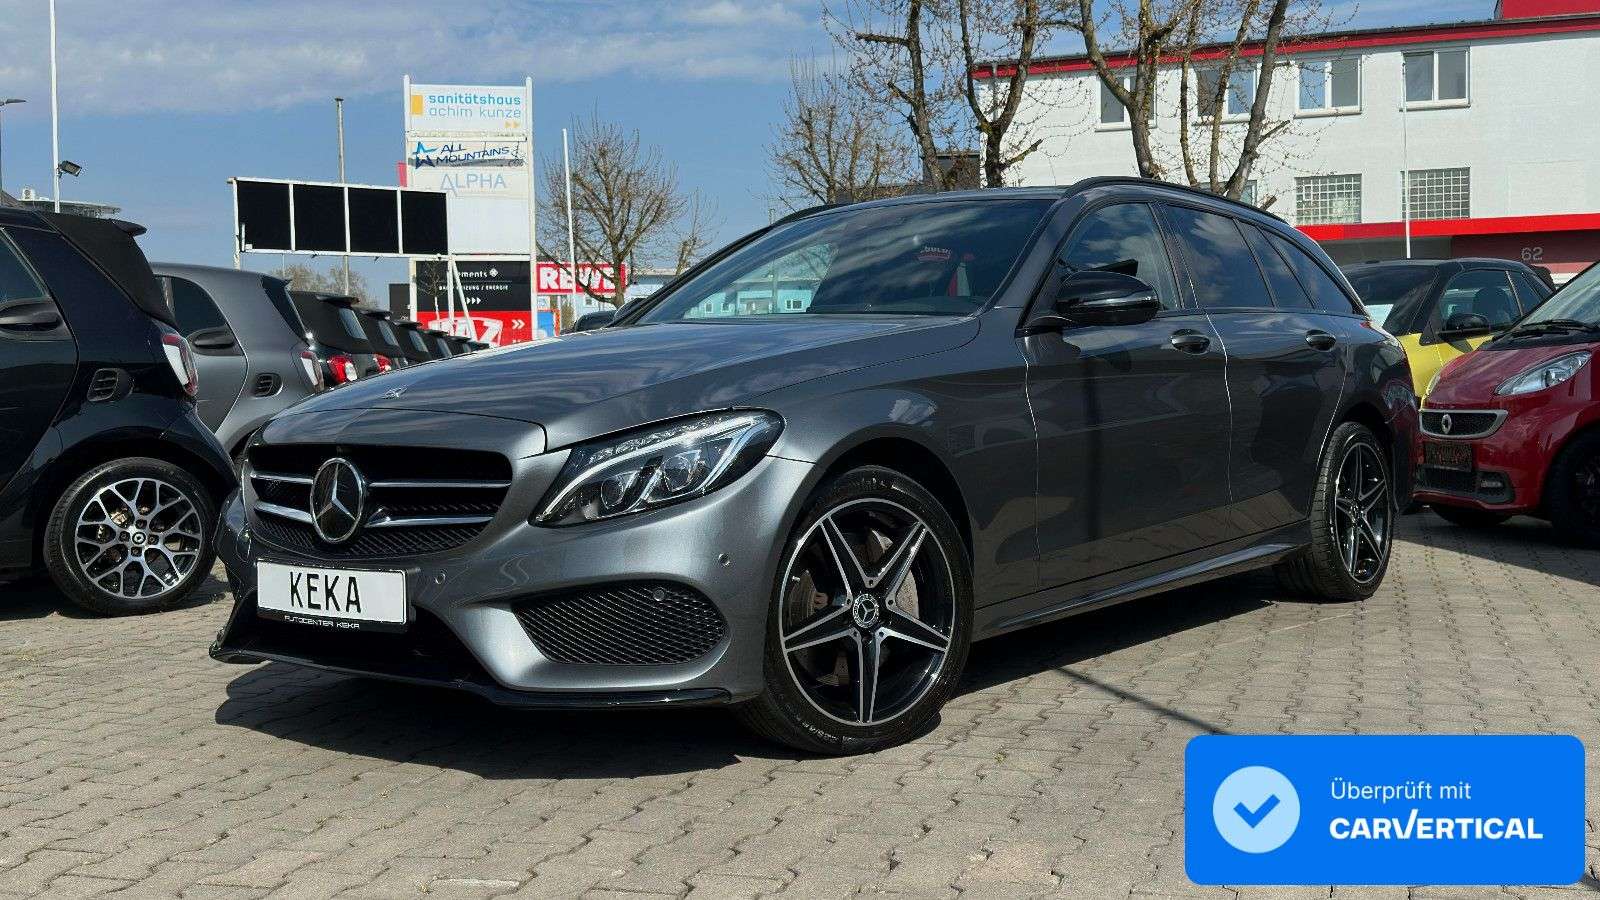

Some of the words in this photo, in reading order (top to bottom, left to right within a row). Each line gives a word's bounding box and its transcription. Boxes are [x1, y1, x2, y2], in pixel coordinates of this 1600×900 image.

[428, 92, 522, 105] sanitätshaus
[429, 105, 473, 118] achim
[479, 107, 522, 119] kunze
[436, 146, 510, 165] MOUNTAINS
[441, 143, 466, 154] ALL
[441, 172, 507, 197] ALPHA
[1521, 246, 1544, 261] 62
[540, 265, 616, 290] REWE
[290, 571, 361, 613] KEKA
[284, 615, 334, 627] AUTOCENTER
